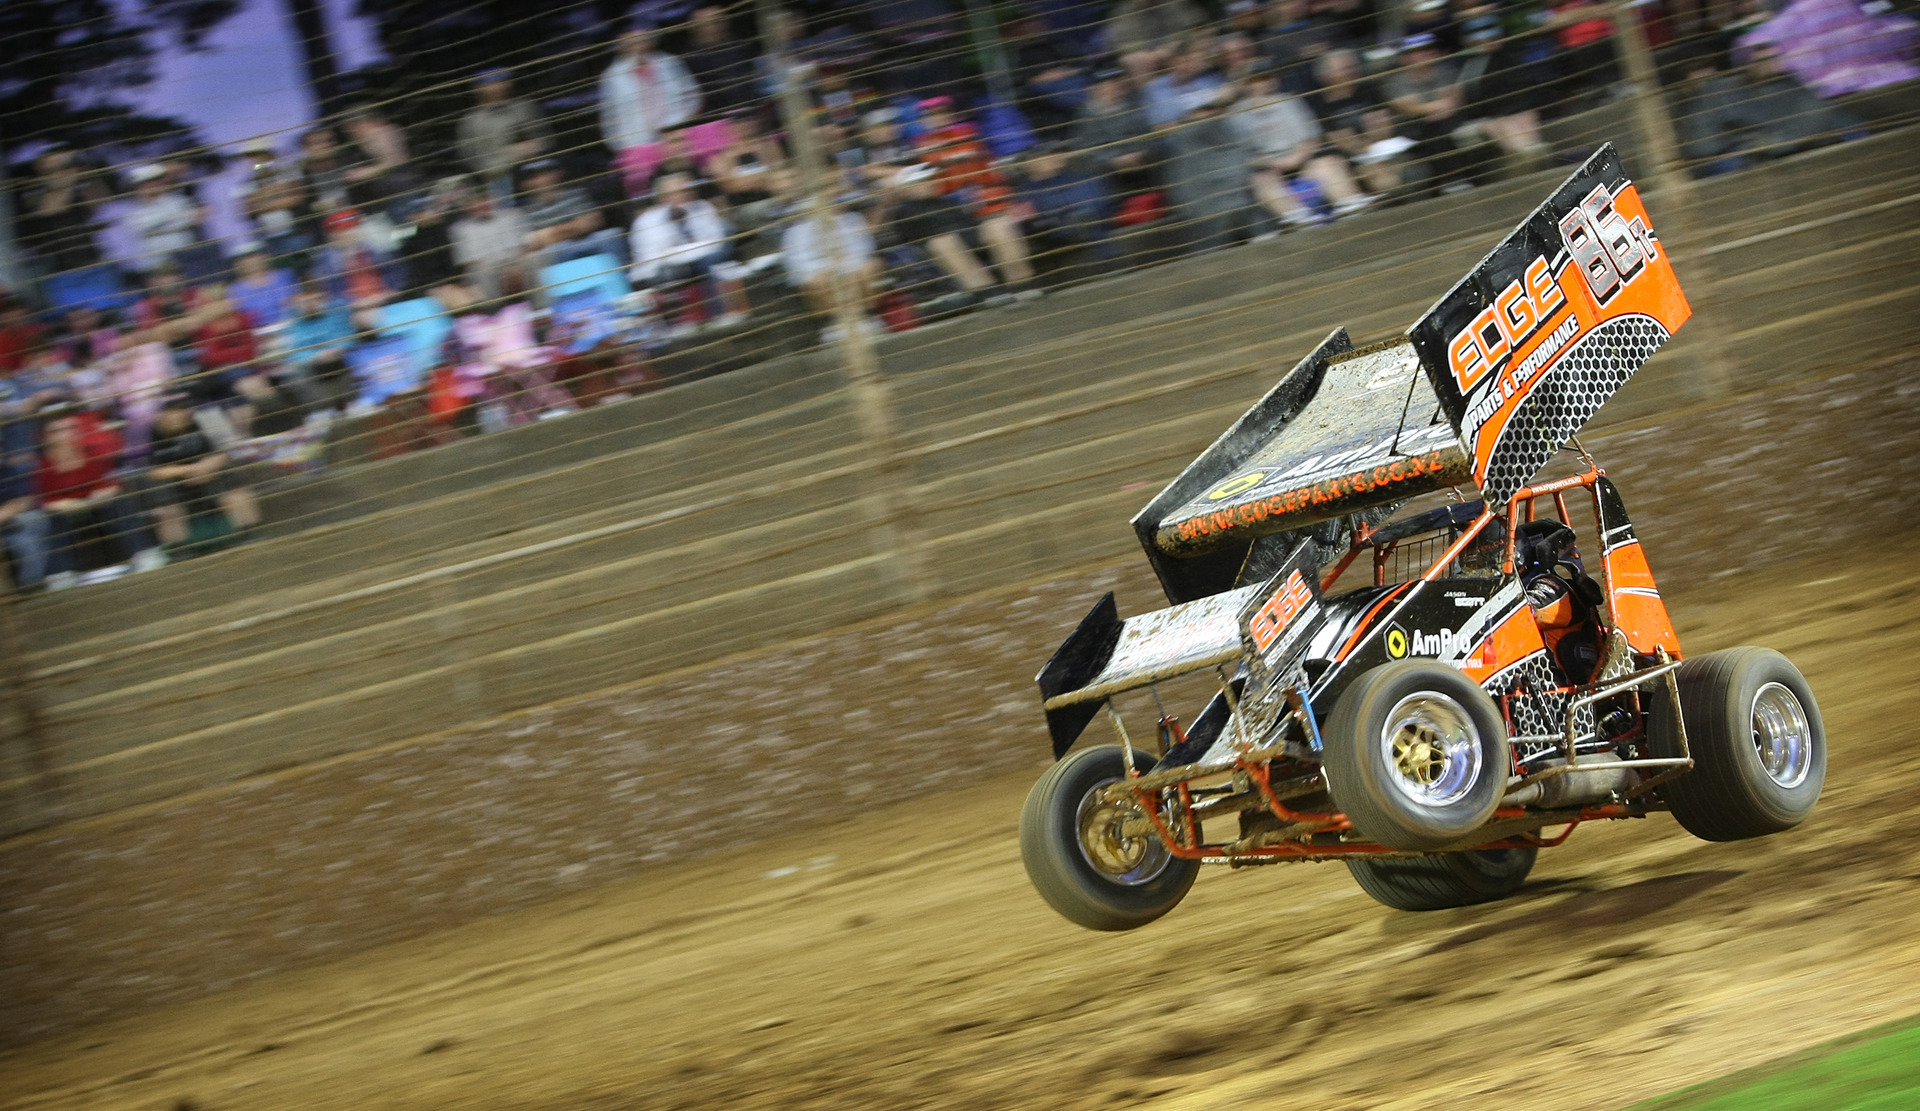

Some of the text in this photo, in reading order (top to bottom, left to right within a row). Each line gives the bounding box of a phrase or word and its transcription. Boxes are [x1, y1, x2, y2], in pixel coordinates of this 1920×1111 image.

[1448, 255, 1567, 396] EDGE
[1468, 313, 1580, 431] PARTS & PERFORMANCE
[1250, 568, 1313, 655] EDGE
[1411, 628, 1472, 656] AmPro
